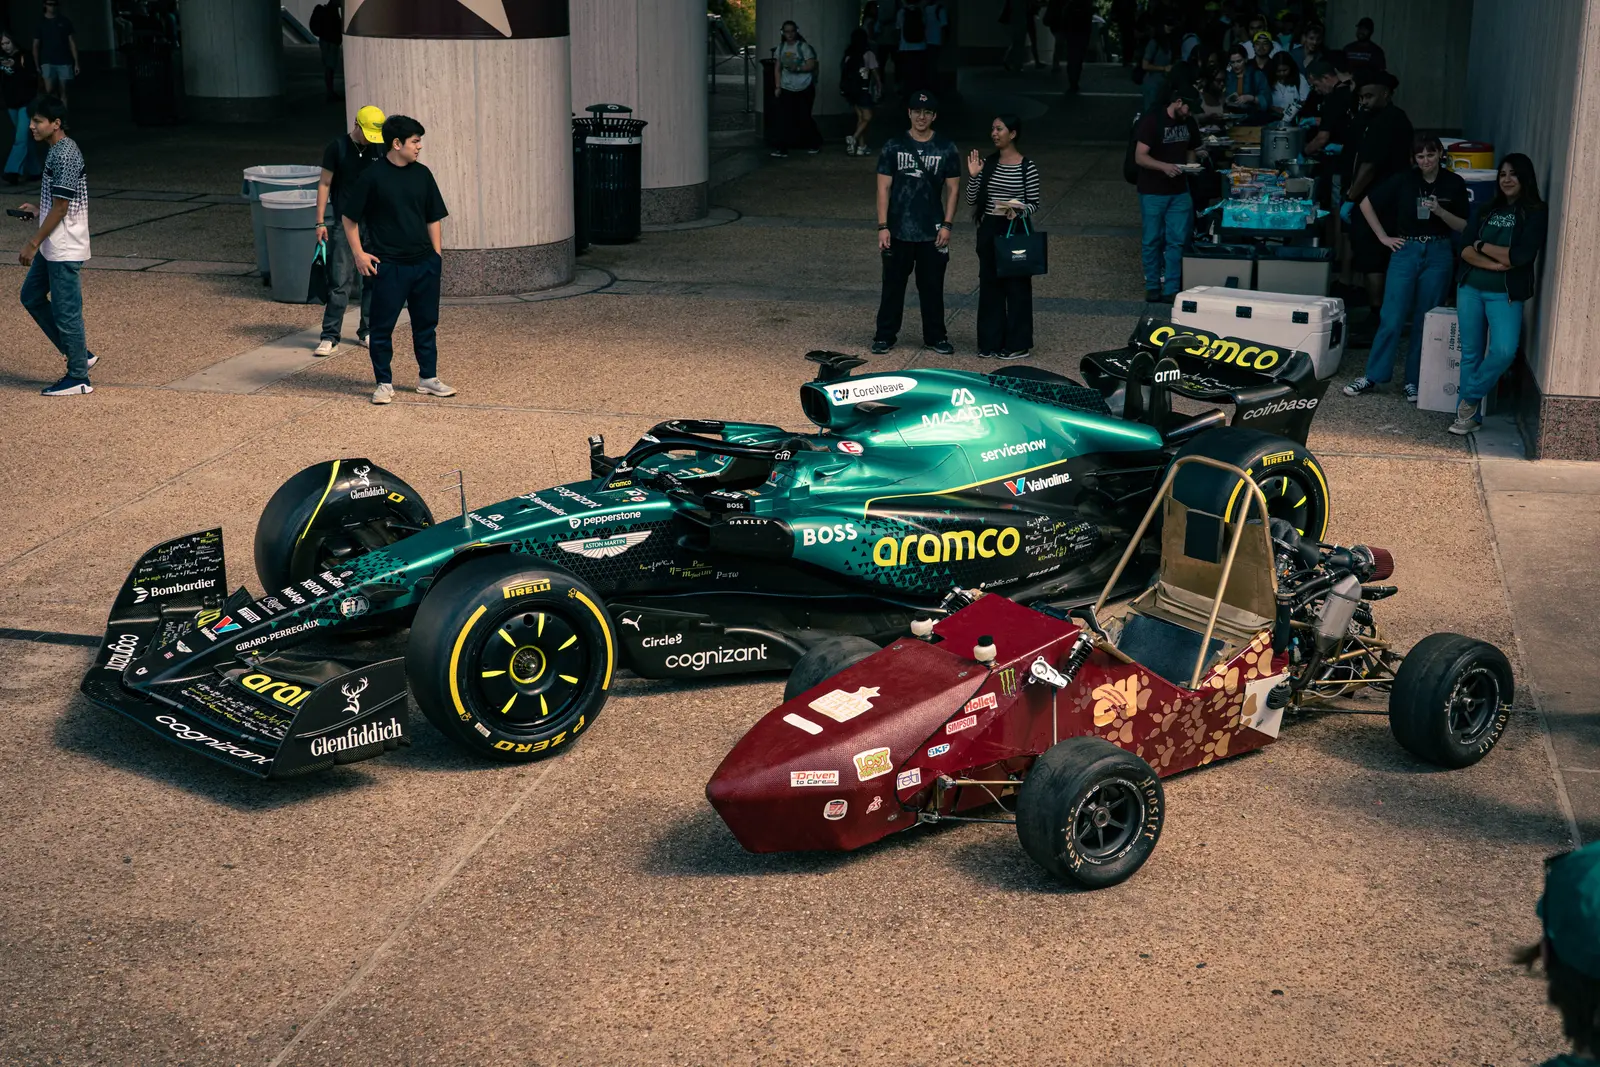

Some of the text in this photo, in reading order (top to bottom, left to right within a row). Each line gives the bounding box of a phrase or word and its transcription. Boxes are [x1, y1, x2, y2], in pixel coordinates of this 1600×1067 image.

[1149, 326, 1279, 370] aamco
[1154, 368, 1181, 384] arm
[852, 382, 905, 398] CoreWeave
[921, 402, 1009, 428] MAADEN
[1242, 397, 1318, 421] coinbase
[774, 450, 791, 460] citi
[980, 438, 1047, 462] servicenow
[1262, 450, 1294, 467] PIRELLI
[350, 485, 386, 500] Glenfiddich
[609, 479, 632, 489] aramco
[583, 511, 641, 527] pepperstone
[584, 538, 626, 549] ASTON MARTIN
[803, 523, 858, 546] BOSS
[873, 526, 1021, 567] aramco
[150, 578, 216, 597] Bombardier
[300, 579, 329, 597] xerox
[319, 570, 345, 589] NexGen
[502, 578, 551, 599] PIRELLI
[281, 586, 306, 605] NetApp
[235, 619, 320, 651] GIRARD-PERREGAUX
[665, 643, 768, 671] cognizant
[947, 717, 975, 733] SIMPSON
[310, 717, 403, 756] Glenfiddich
[493, 731, 567, 753] ZERO
[856, 749, 889, 771] LOST
[928, 744, 949, 757] SKF
[796, 771, 836, 780] Driven
